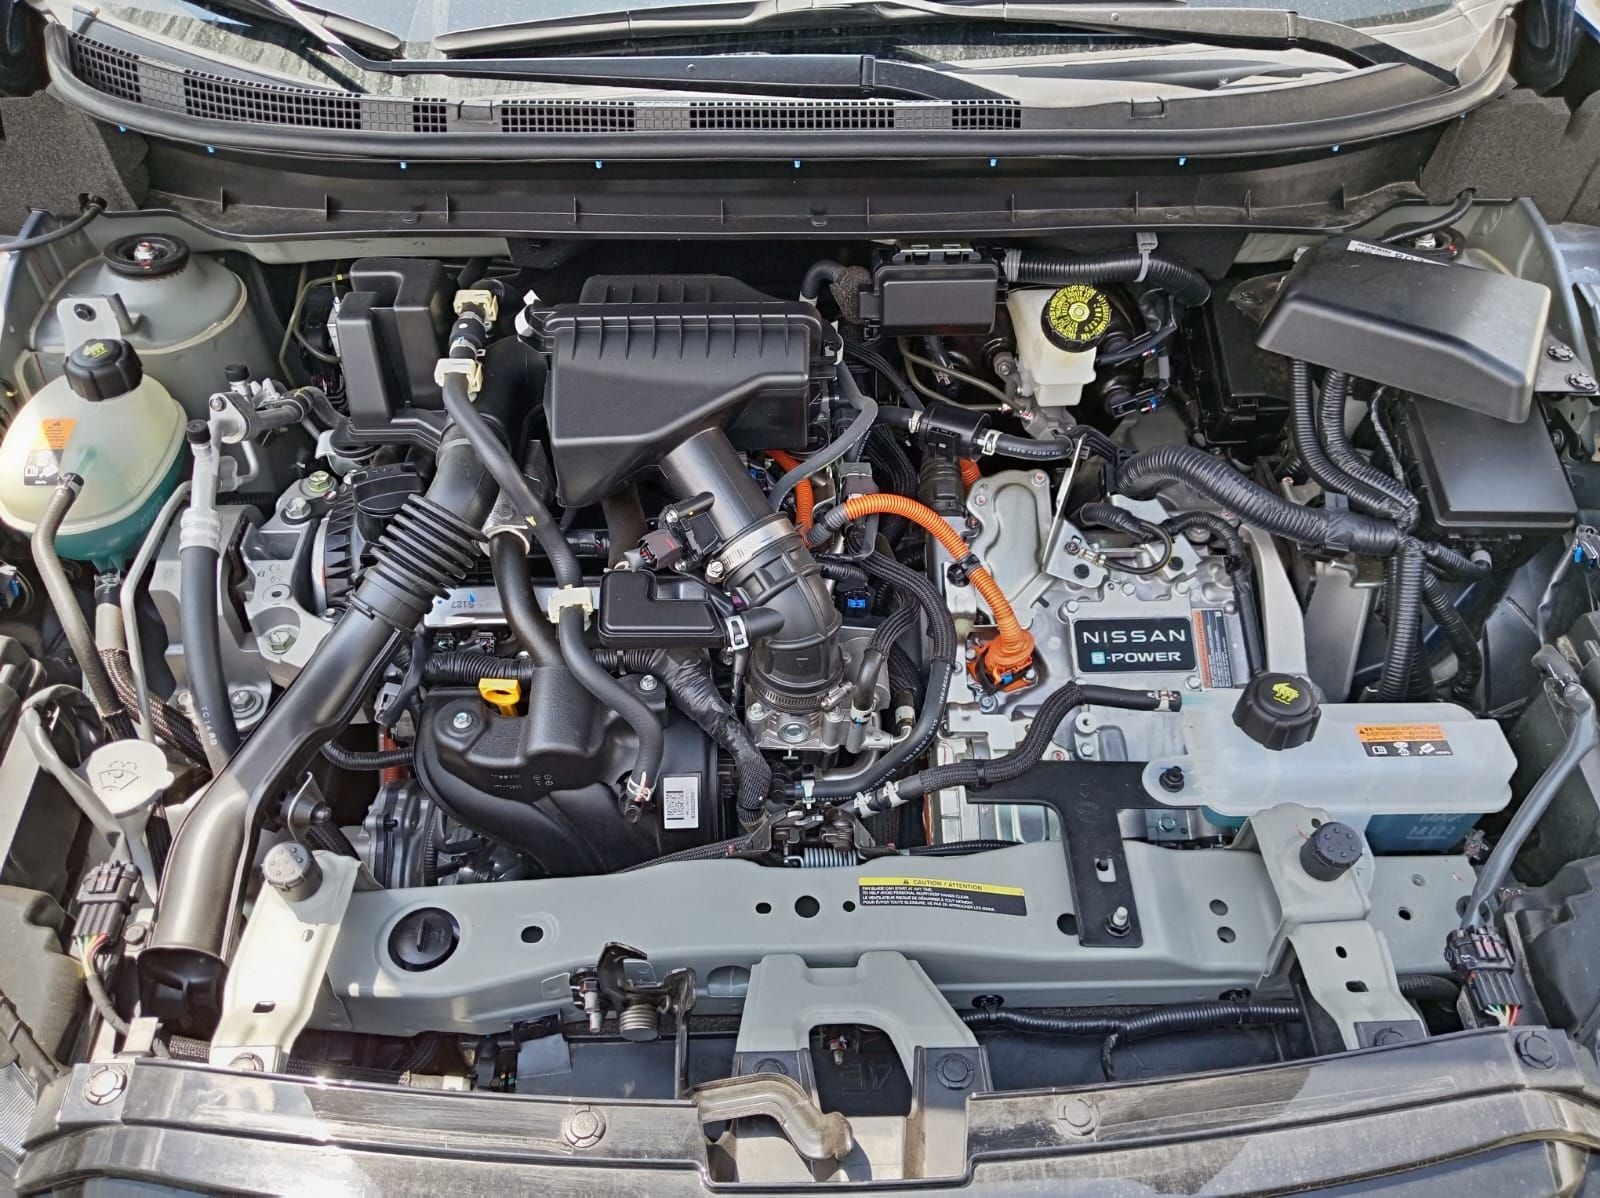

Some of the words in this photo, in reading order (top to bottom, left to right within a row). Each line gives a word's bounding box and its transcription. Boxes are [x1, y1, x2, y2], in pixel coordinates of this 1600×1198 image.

[1083, 629, 1186, 644] NISSAN
[1091, 651, 1182, 665] e-POWER
[948, 882, 983, 890] ATTENTION
